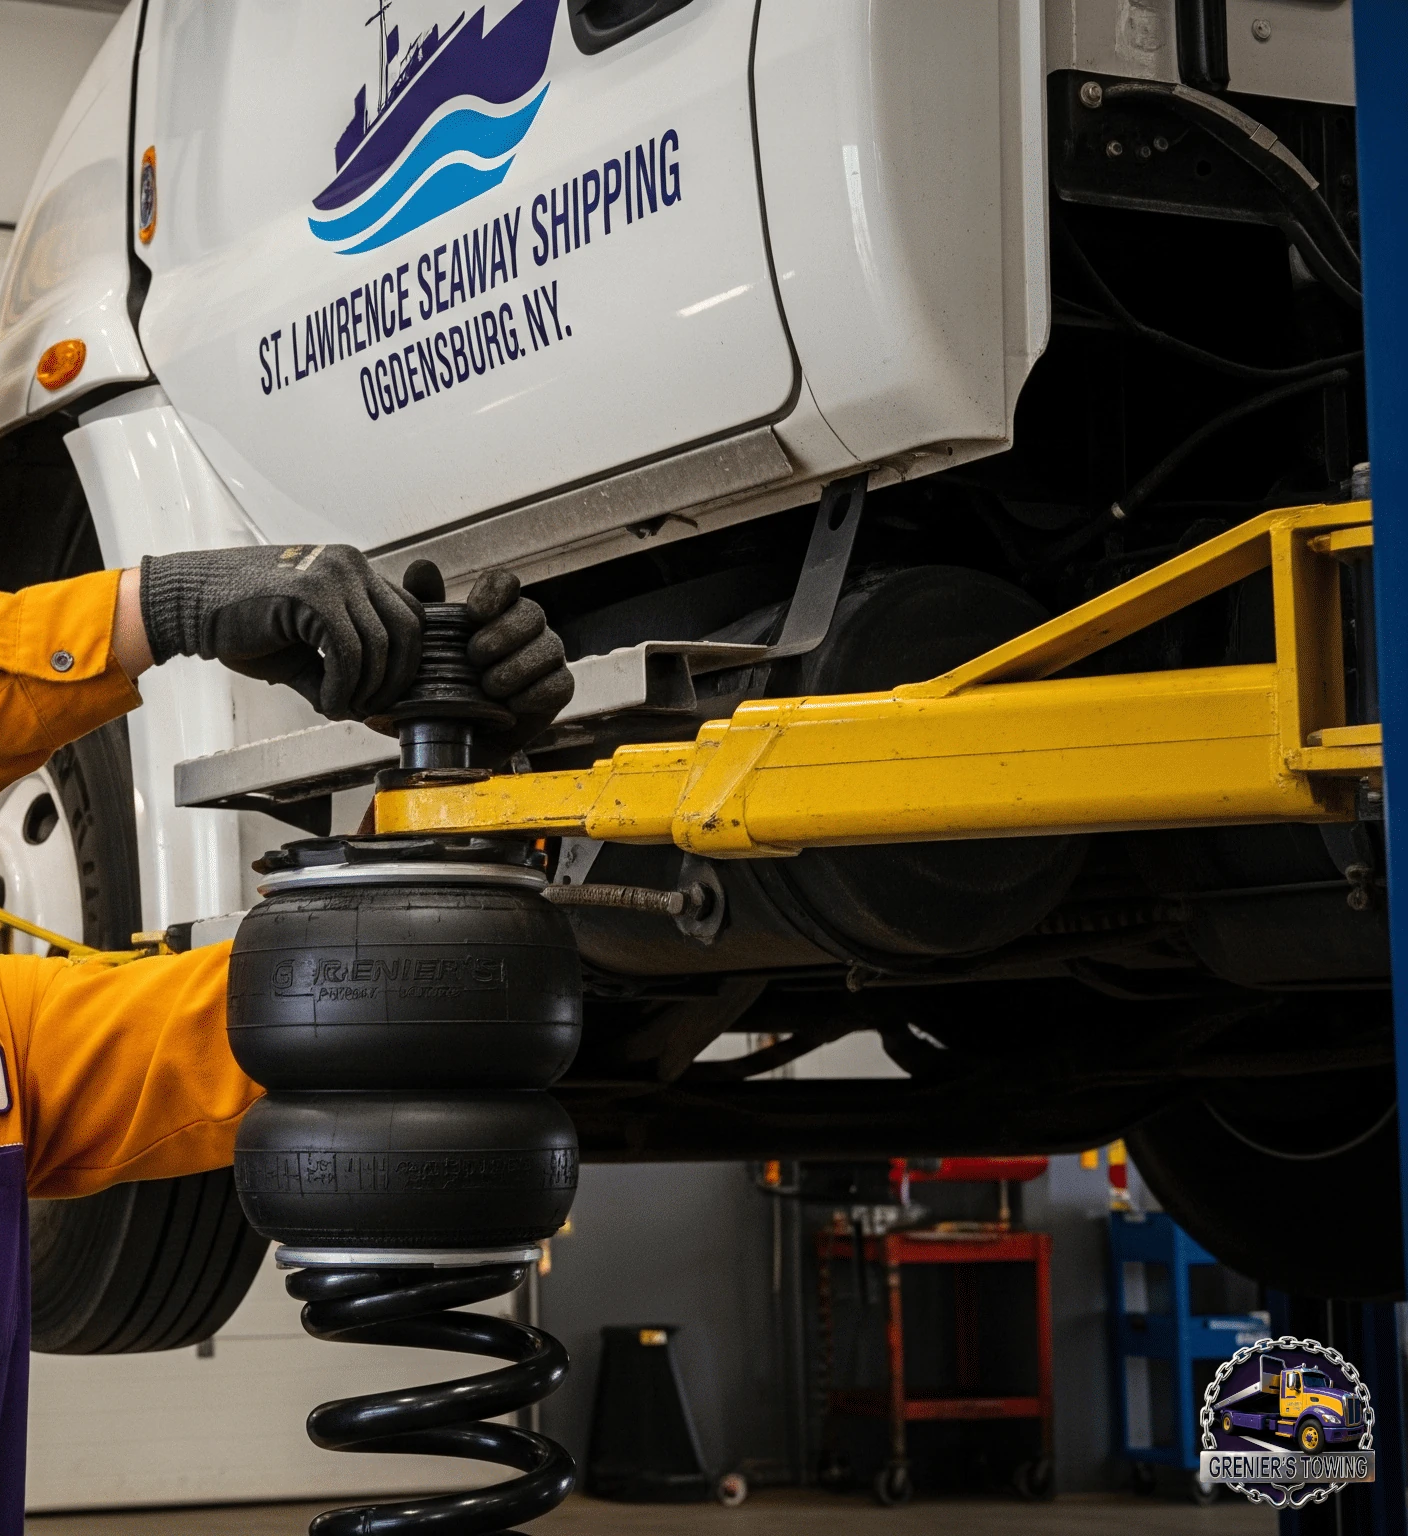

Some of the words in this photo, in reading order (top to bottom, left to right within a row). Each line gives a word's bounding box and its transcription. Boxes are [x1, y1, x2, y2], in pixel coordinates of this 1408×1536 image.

[259, 329, 289, 396] ST.
[291, 262, 412, 382] LAWRENCE
[417, 205, 521, 321] SEAWAY
[531, 128, 682, 267] SHIPPING
[522, 280, 573, 352] NY.
